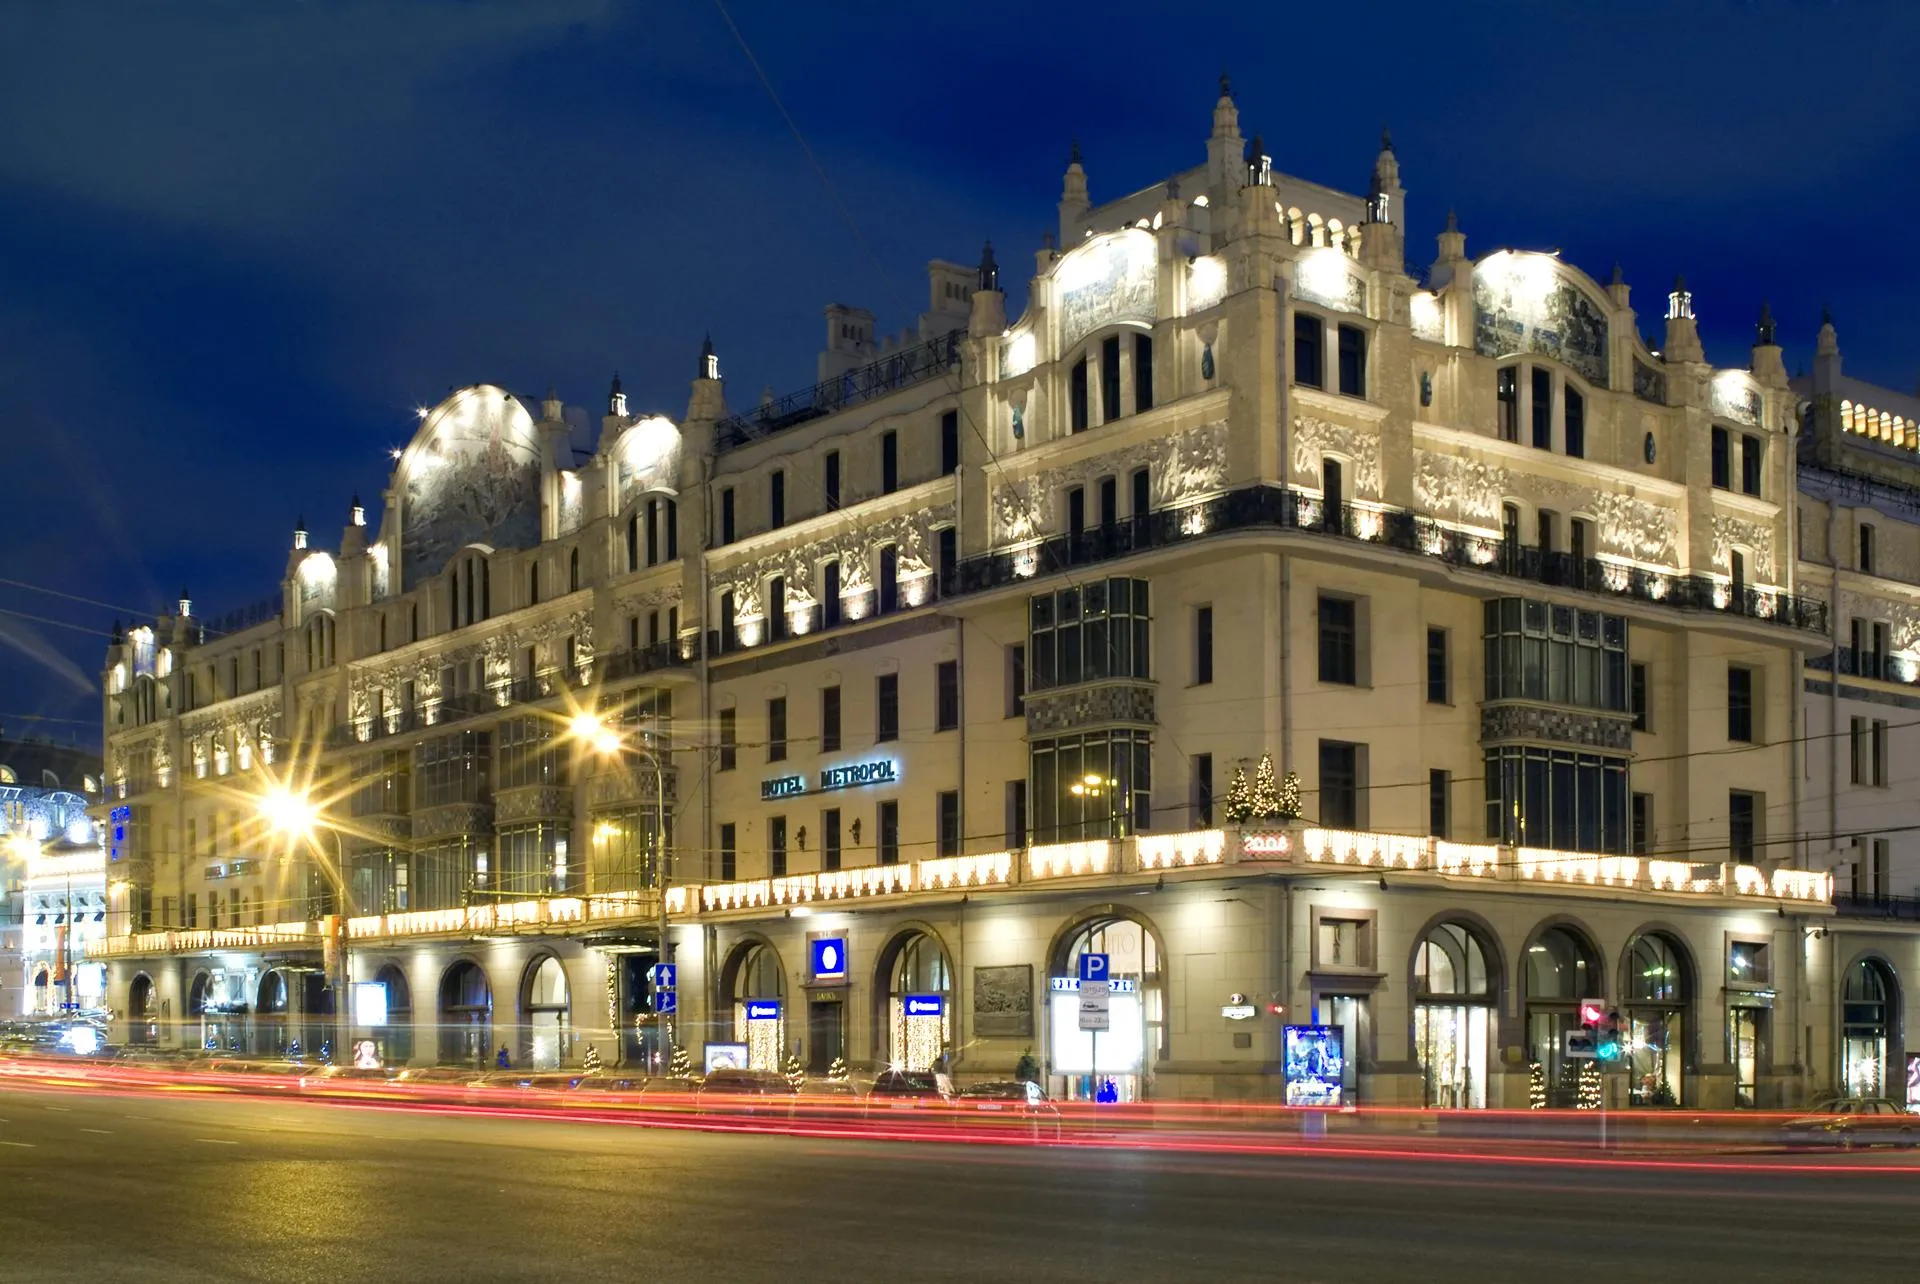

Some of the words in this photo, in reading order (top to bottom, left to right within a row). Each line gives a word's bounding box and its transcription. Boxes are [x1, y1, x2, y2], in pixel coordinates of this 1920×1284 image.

[761, 775, 803, 797] HOTEL
[821, 760, 895, 788] METROPOL
[1087, 956, 1104, 978] P
